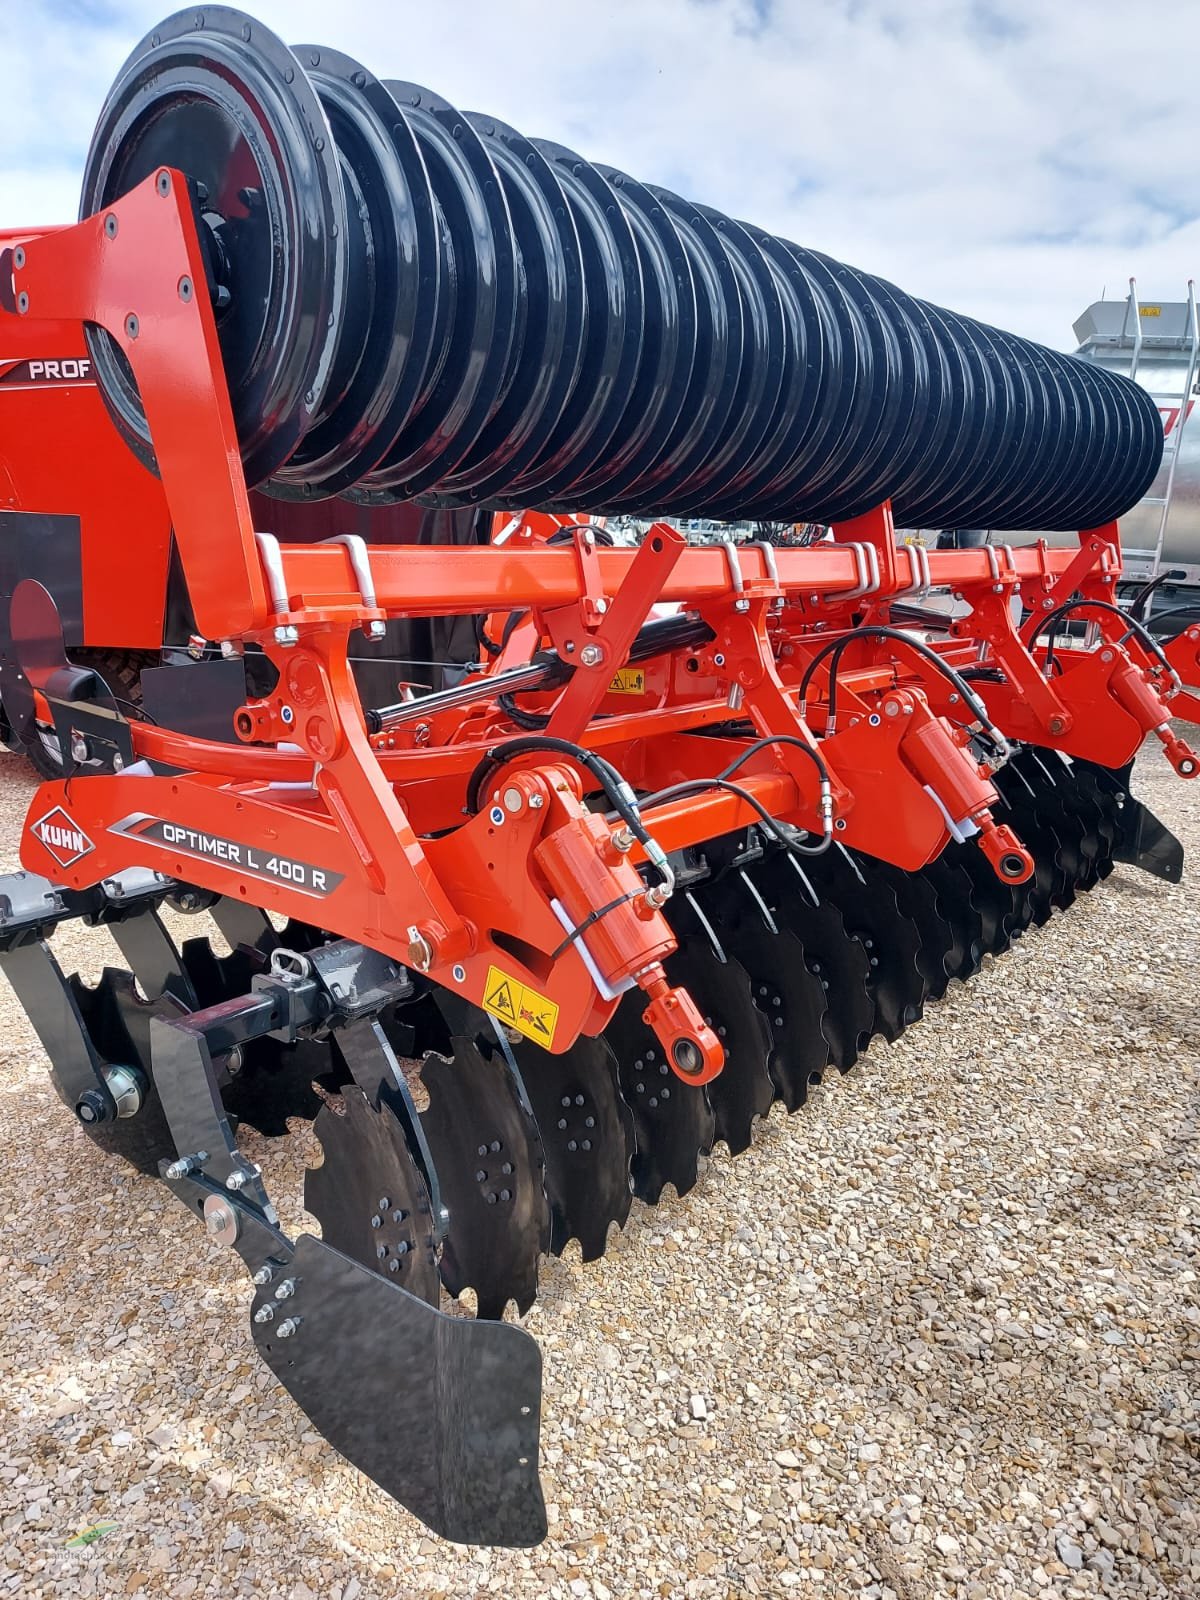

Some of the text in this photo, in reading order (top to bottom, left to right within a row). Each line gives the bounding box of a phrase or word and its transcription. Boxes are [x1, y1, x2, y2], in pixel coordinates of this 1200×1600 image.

[29, 360, 91, 379] PROF
[40, 822, 84, 853] KUHN
[163, 824, 327, 890] OPTIMER L 400 R
